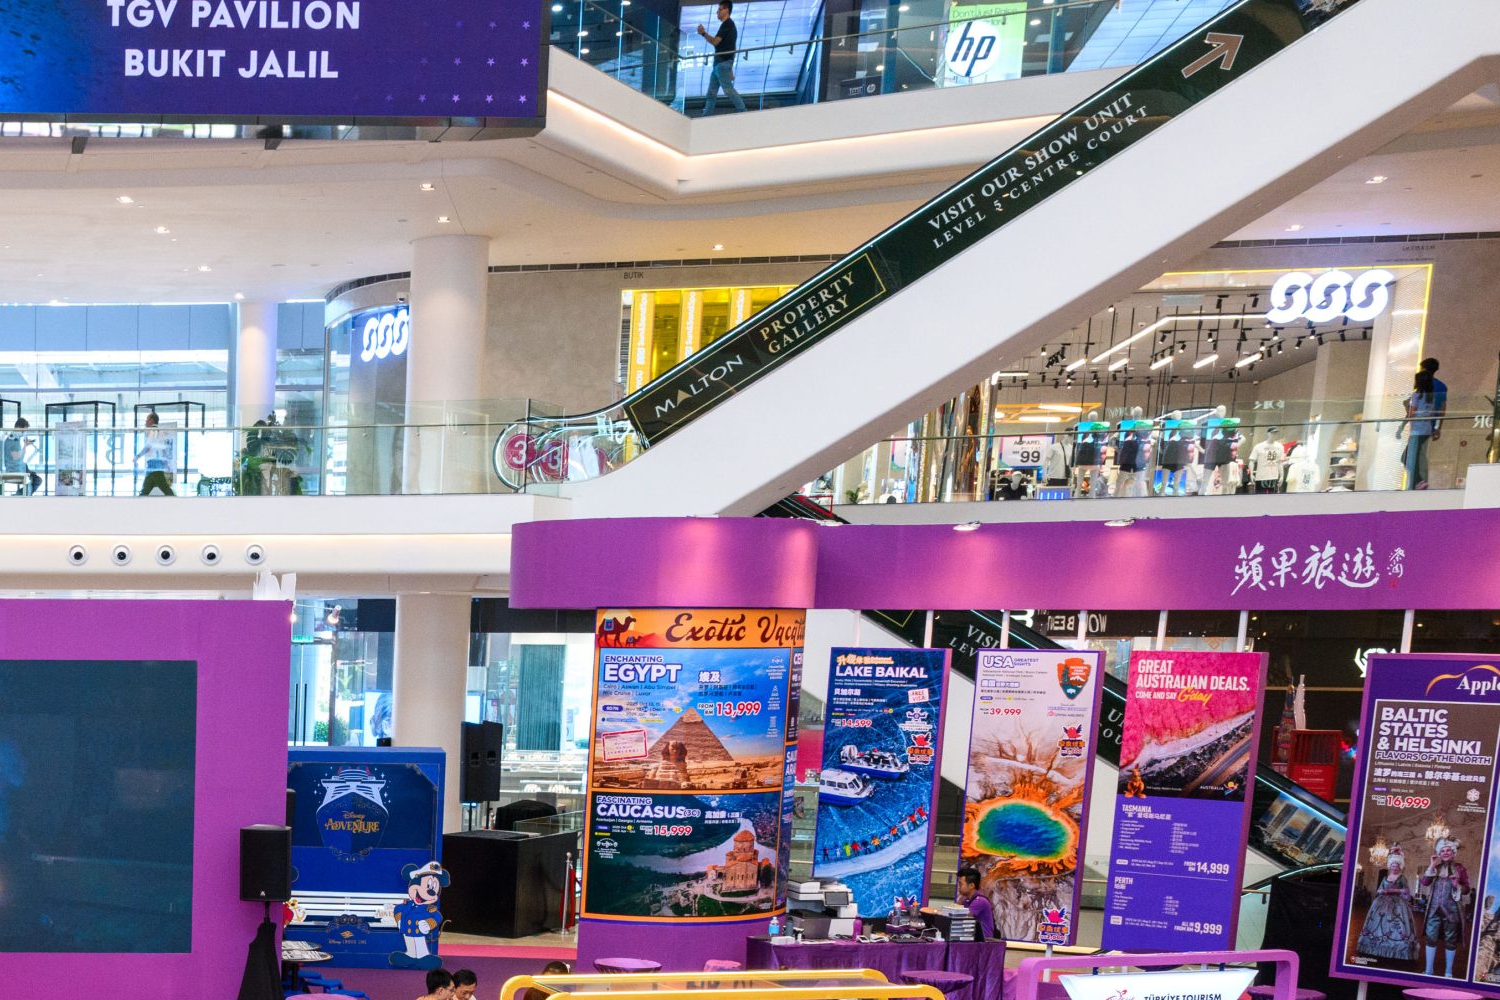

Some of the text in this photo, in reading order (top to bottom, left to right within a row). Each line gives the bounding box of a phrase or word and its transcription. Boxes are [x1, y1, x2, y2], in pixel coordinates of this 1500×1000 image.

[107, 0, 360, 30] TGV PAVILION
[951, 22, 997, 77] hp
[124, 48, 339, 79] BUKIT JALIL
[928, 92, 1133, 230] VISIT OUR SHOW UNIT
[933, 211, 986, 249] LEVEL
[1009, 150, 1079, 199] CENTRE
[1087, 105, 1148, 150] COURT
[759, 270, 856, 342] PROPERTY
[767, 295, 850, 354] GALLERY
[654, 354, 744, 419] MALTON
[512, 440, 528, 465] 3
[547, 447, 561, 470] 3
[1020, 450, 1041, 463] 99
[665, 612, 746, 643] Exotic
[967, 625, 1000, 649] VISI
[949, 637, 978, 658] LEV
[604, 655, 663, 663] ENCHANTING
[982, 655, 1015, 669] USA
[1137, 659, 1174, 674] GREAT
[603, 662, 682, 683] EGYPT
[835, 665, 929, 678] LAKE BAIKAL
[1135, 674, 1251, 691] AUSTRALIAN DEALS.
[1135, 691, 1152, 699] COME
[1165, 692, 1177, 700] SAY
[715, 701, 762, 718] 13,999
[990, 707, 1022, 717] 39,999
[1381, 707, 1449, 723] BALTIC
[1379, 721, 1449, 738] STATES
[1376, 736, 1482, 755] & HELSINKI
[1375, 751, 1492, 765] FLAVORS OF THE NORTH
[596, 795, 652, 805] FASCINATING
[1122, 804, 1152, 812] TASMANIA
[1386, 795, 1431, 809] 16,999
[324, 817, 380, 834] ADVENTURE
[653, 825, 692, 836] 15,999
[1196, 861, 1230, 875] 14,999
[1114, 876, 1133, 885] PERTH
[1194, 921, 1223, 935] 9,999
